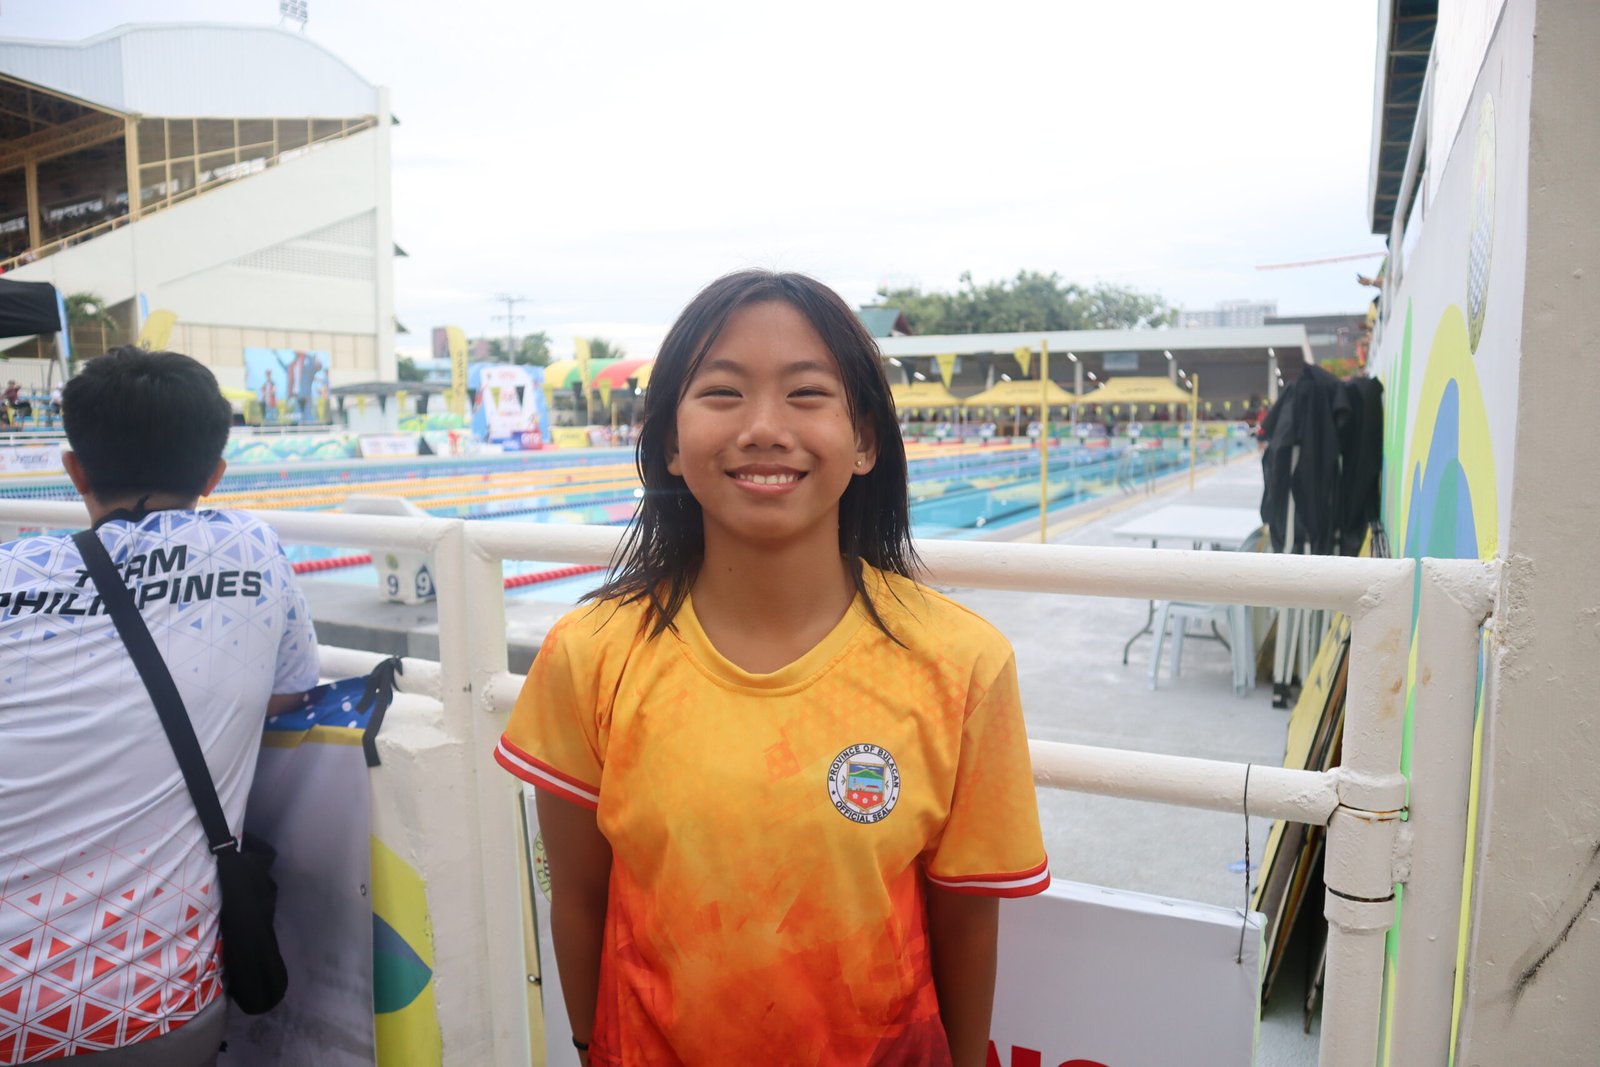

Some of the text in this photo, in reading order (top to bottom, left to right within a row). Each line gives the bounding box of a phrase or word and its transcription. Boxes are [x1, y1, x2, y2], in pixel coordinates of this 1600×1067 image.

[75, 544, 188, 587] TAM
[387, 574, 399, 596] 9
[417, 572, 430, 596] 9
[829, 745, 899, 788] PROVINCE OF BULACAN
[835, 800, 891, 823] OFFICIAL SEAL
